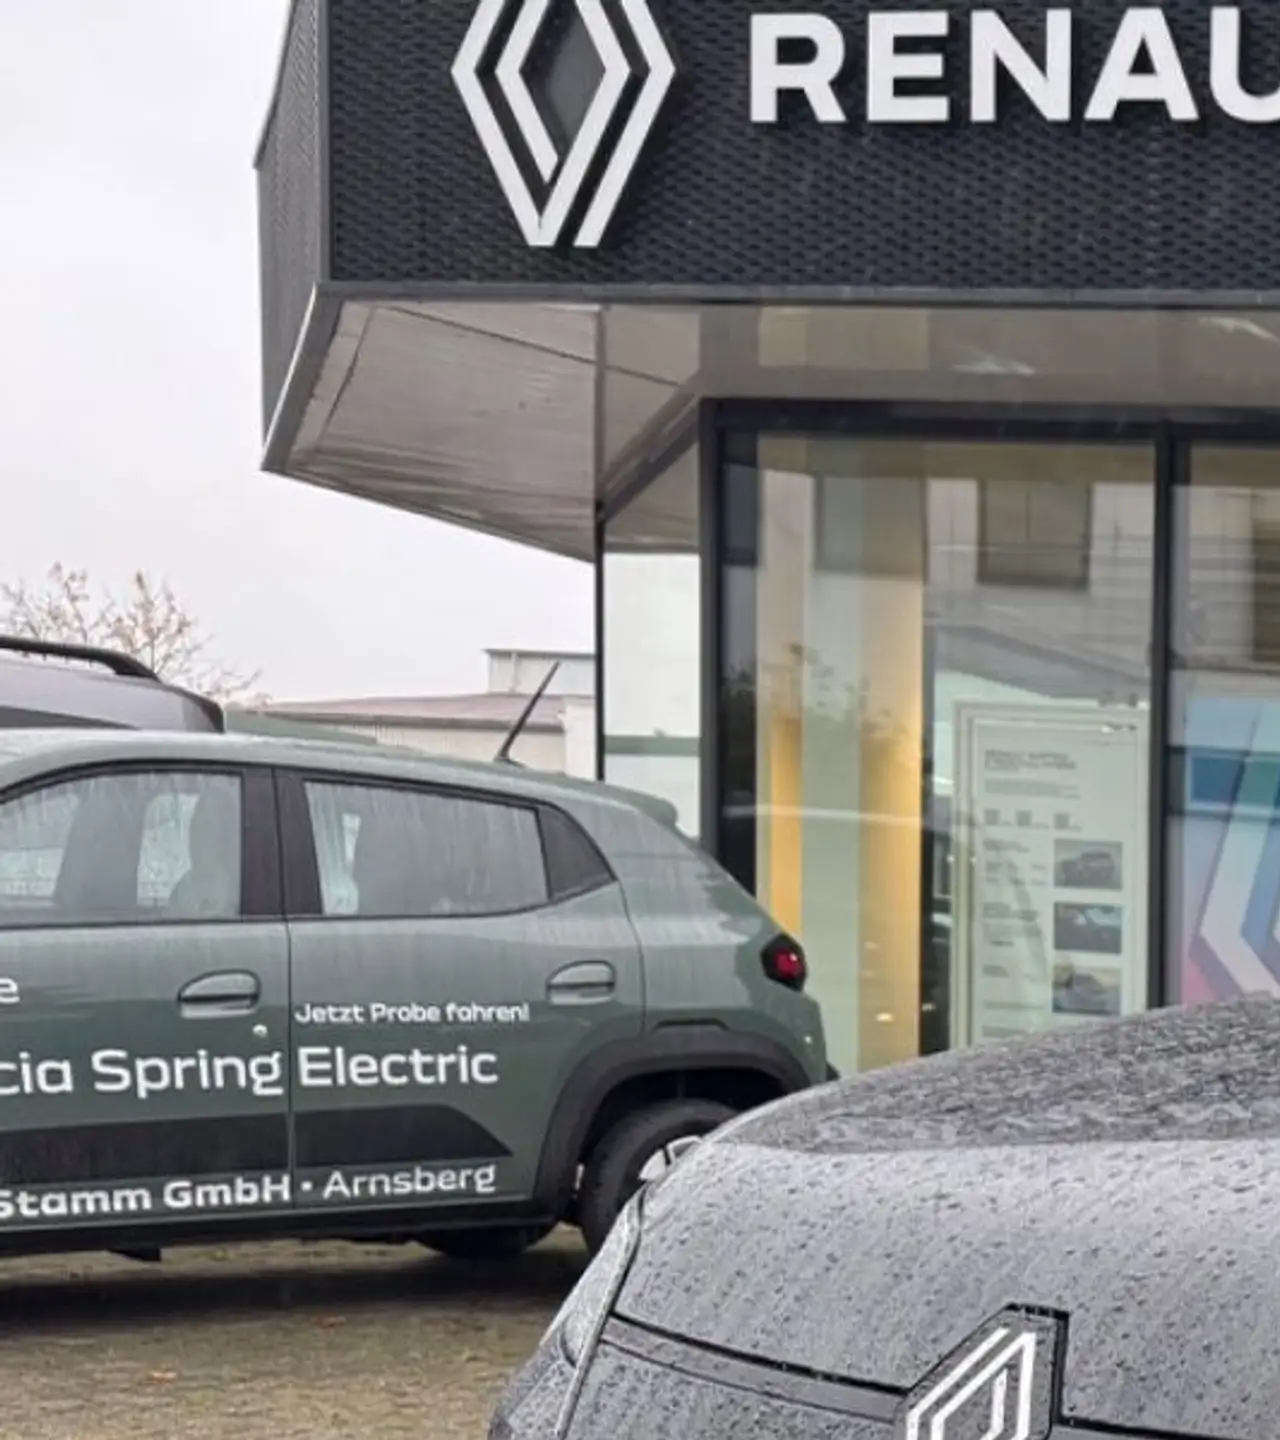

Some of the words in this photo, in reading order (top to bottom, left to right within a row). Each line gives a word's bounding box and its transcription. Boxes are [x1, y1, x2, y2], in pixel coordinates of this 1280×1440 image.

[295, 1003, 364, 1024] Jetzt
[370, 1003, 440, 1023] Probe
[91, 1049, 284, 1099] Spring
[298, 1045, 499, 1087] Electric
[163, 1174, 290, 1208] GmbH
[322, 1164, 496, 1200] Arnsberg
